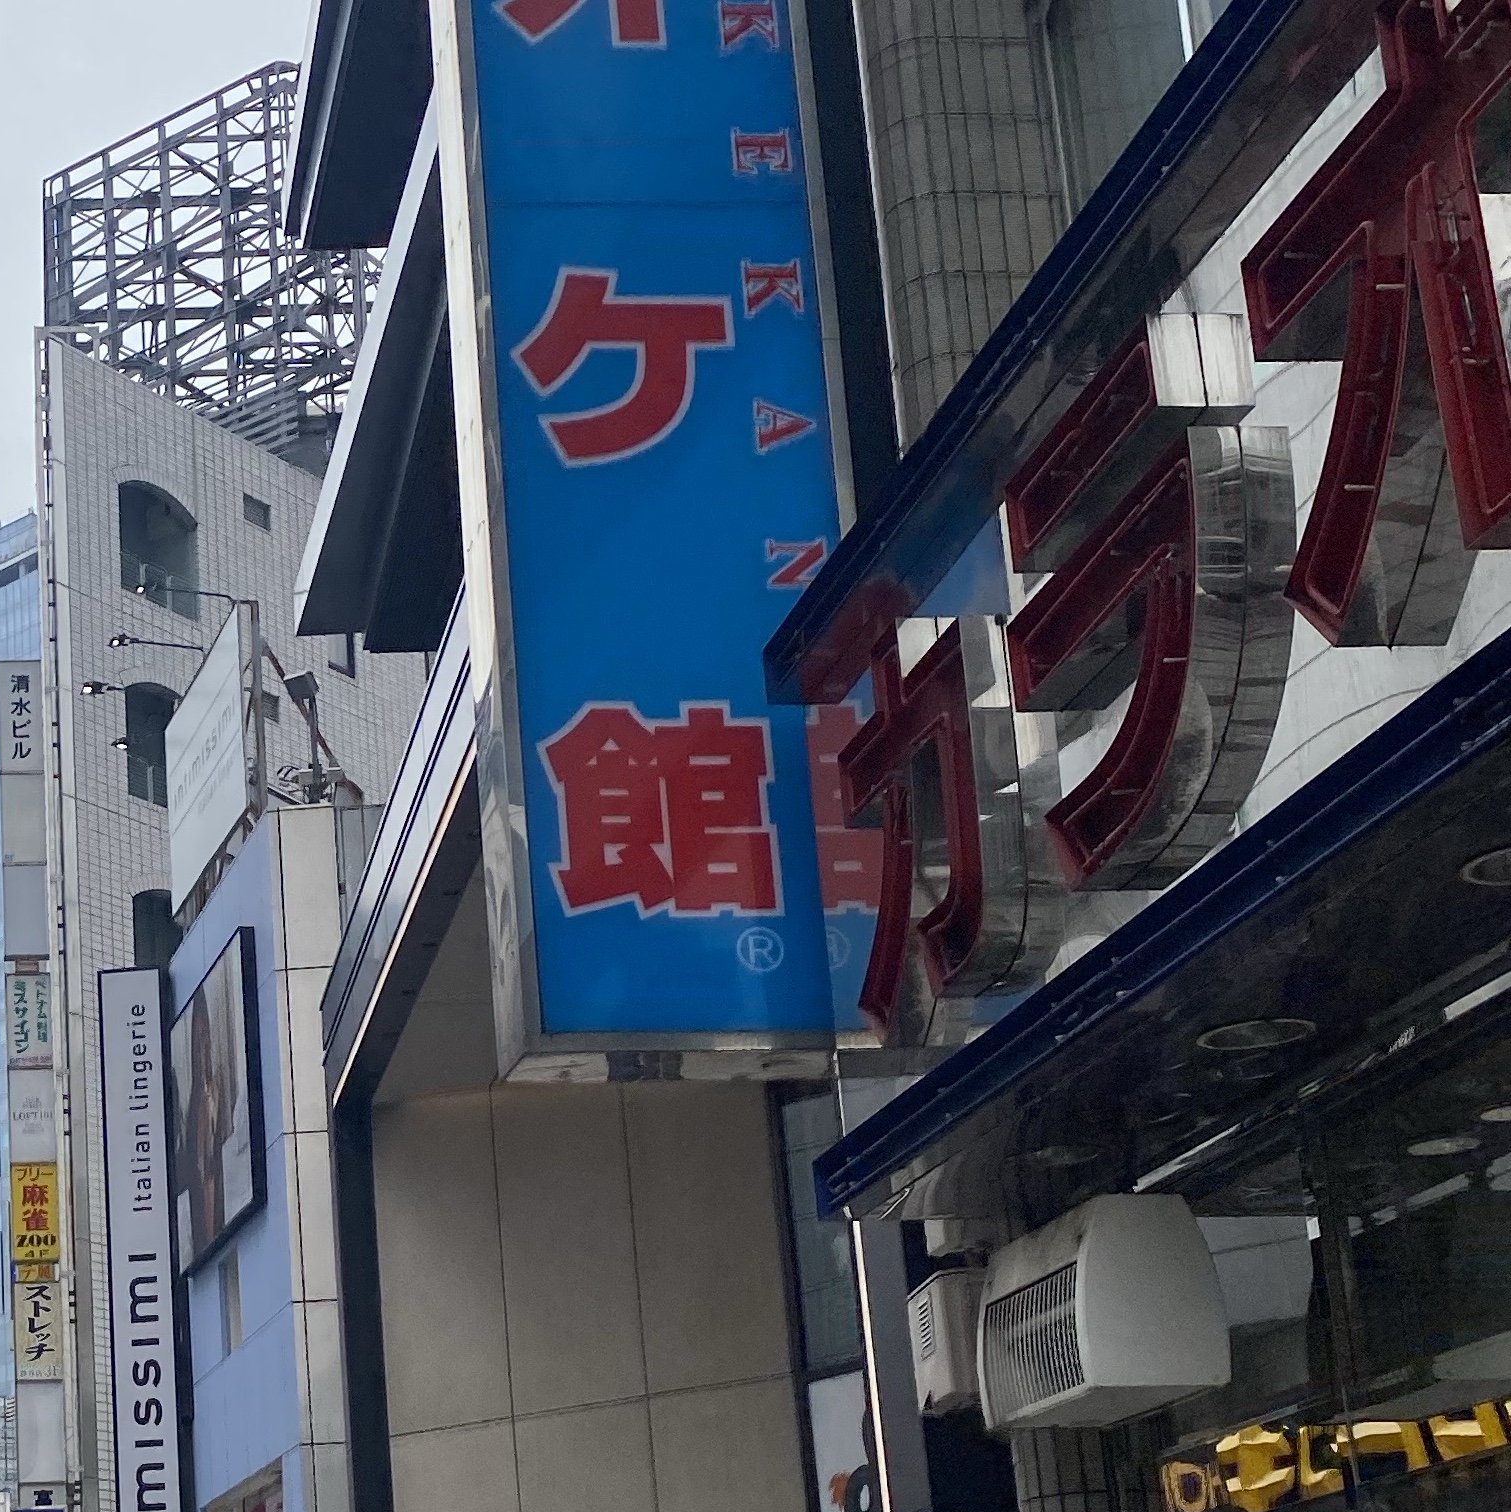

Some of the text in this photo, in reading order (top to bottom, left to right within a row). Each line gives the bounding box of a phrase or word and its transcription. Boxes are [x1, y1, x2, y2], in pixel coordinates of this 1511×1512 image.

[129, 1002, 154, 1111] lingerie
[21, 1183, 50, 1232] 麻雀
[132, 1122, 153, 1212] Italian
[24, 1284, 55, 1363] ストレッチ
